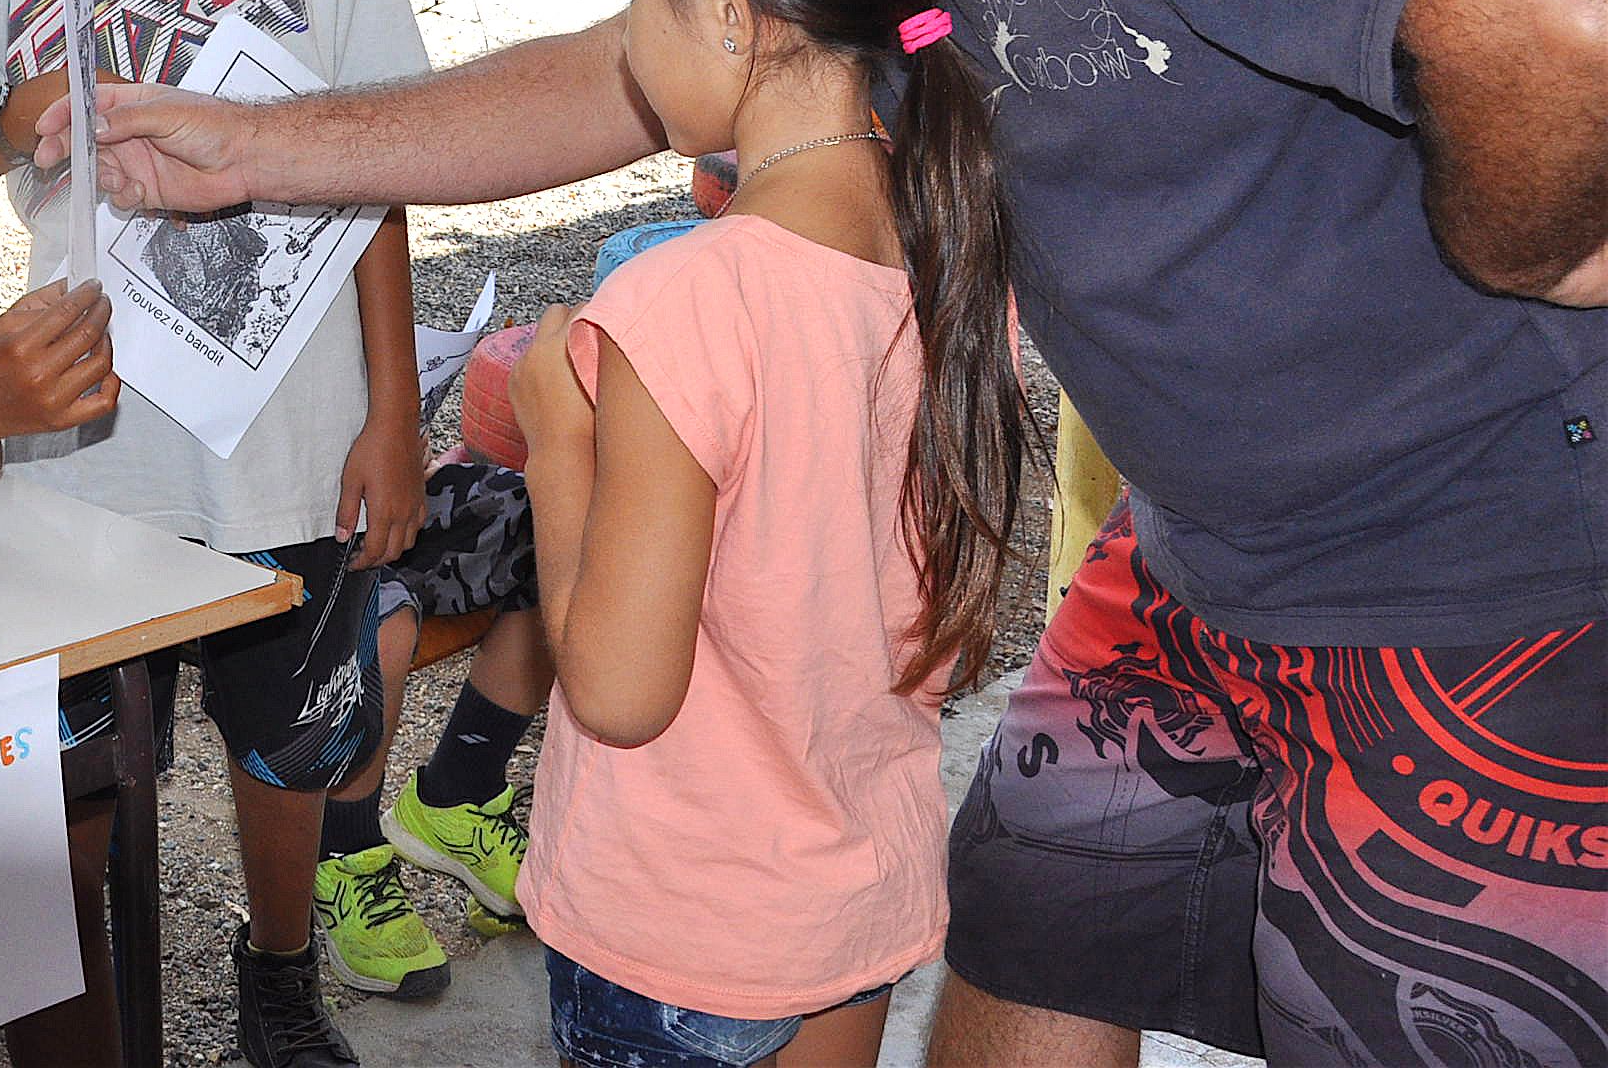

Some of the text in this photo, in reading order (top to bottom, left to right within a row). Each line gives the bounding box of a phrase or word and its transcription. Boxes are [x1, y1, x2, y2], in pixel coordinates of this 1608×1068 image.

[121, 278, 225, 367] Trouvez le bandit
